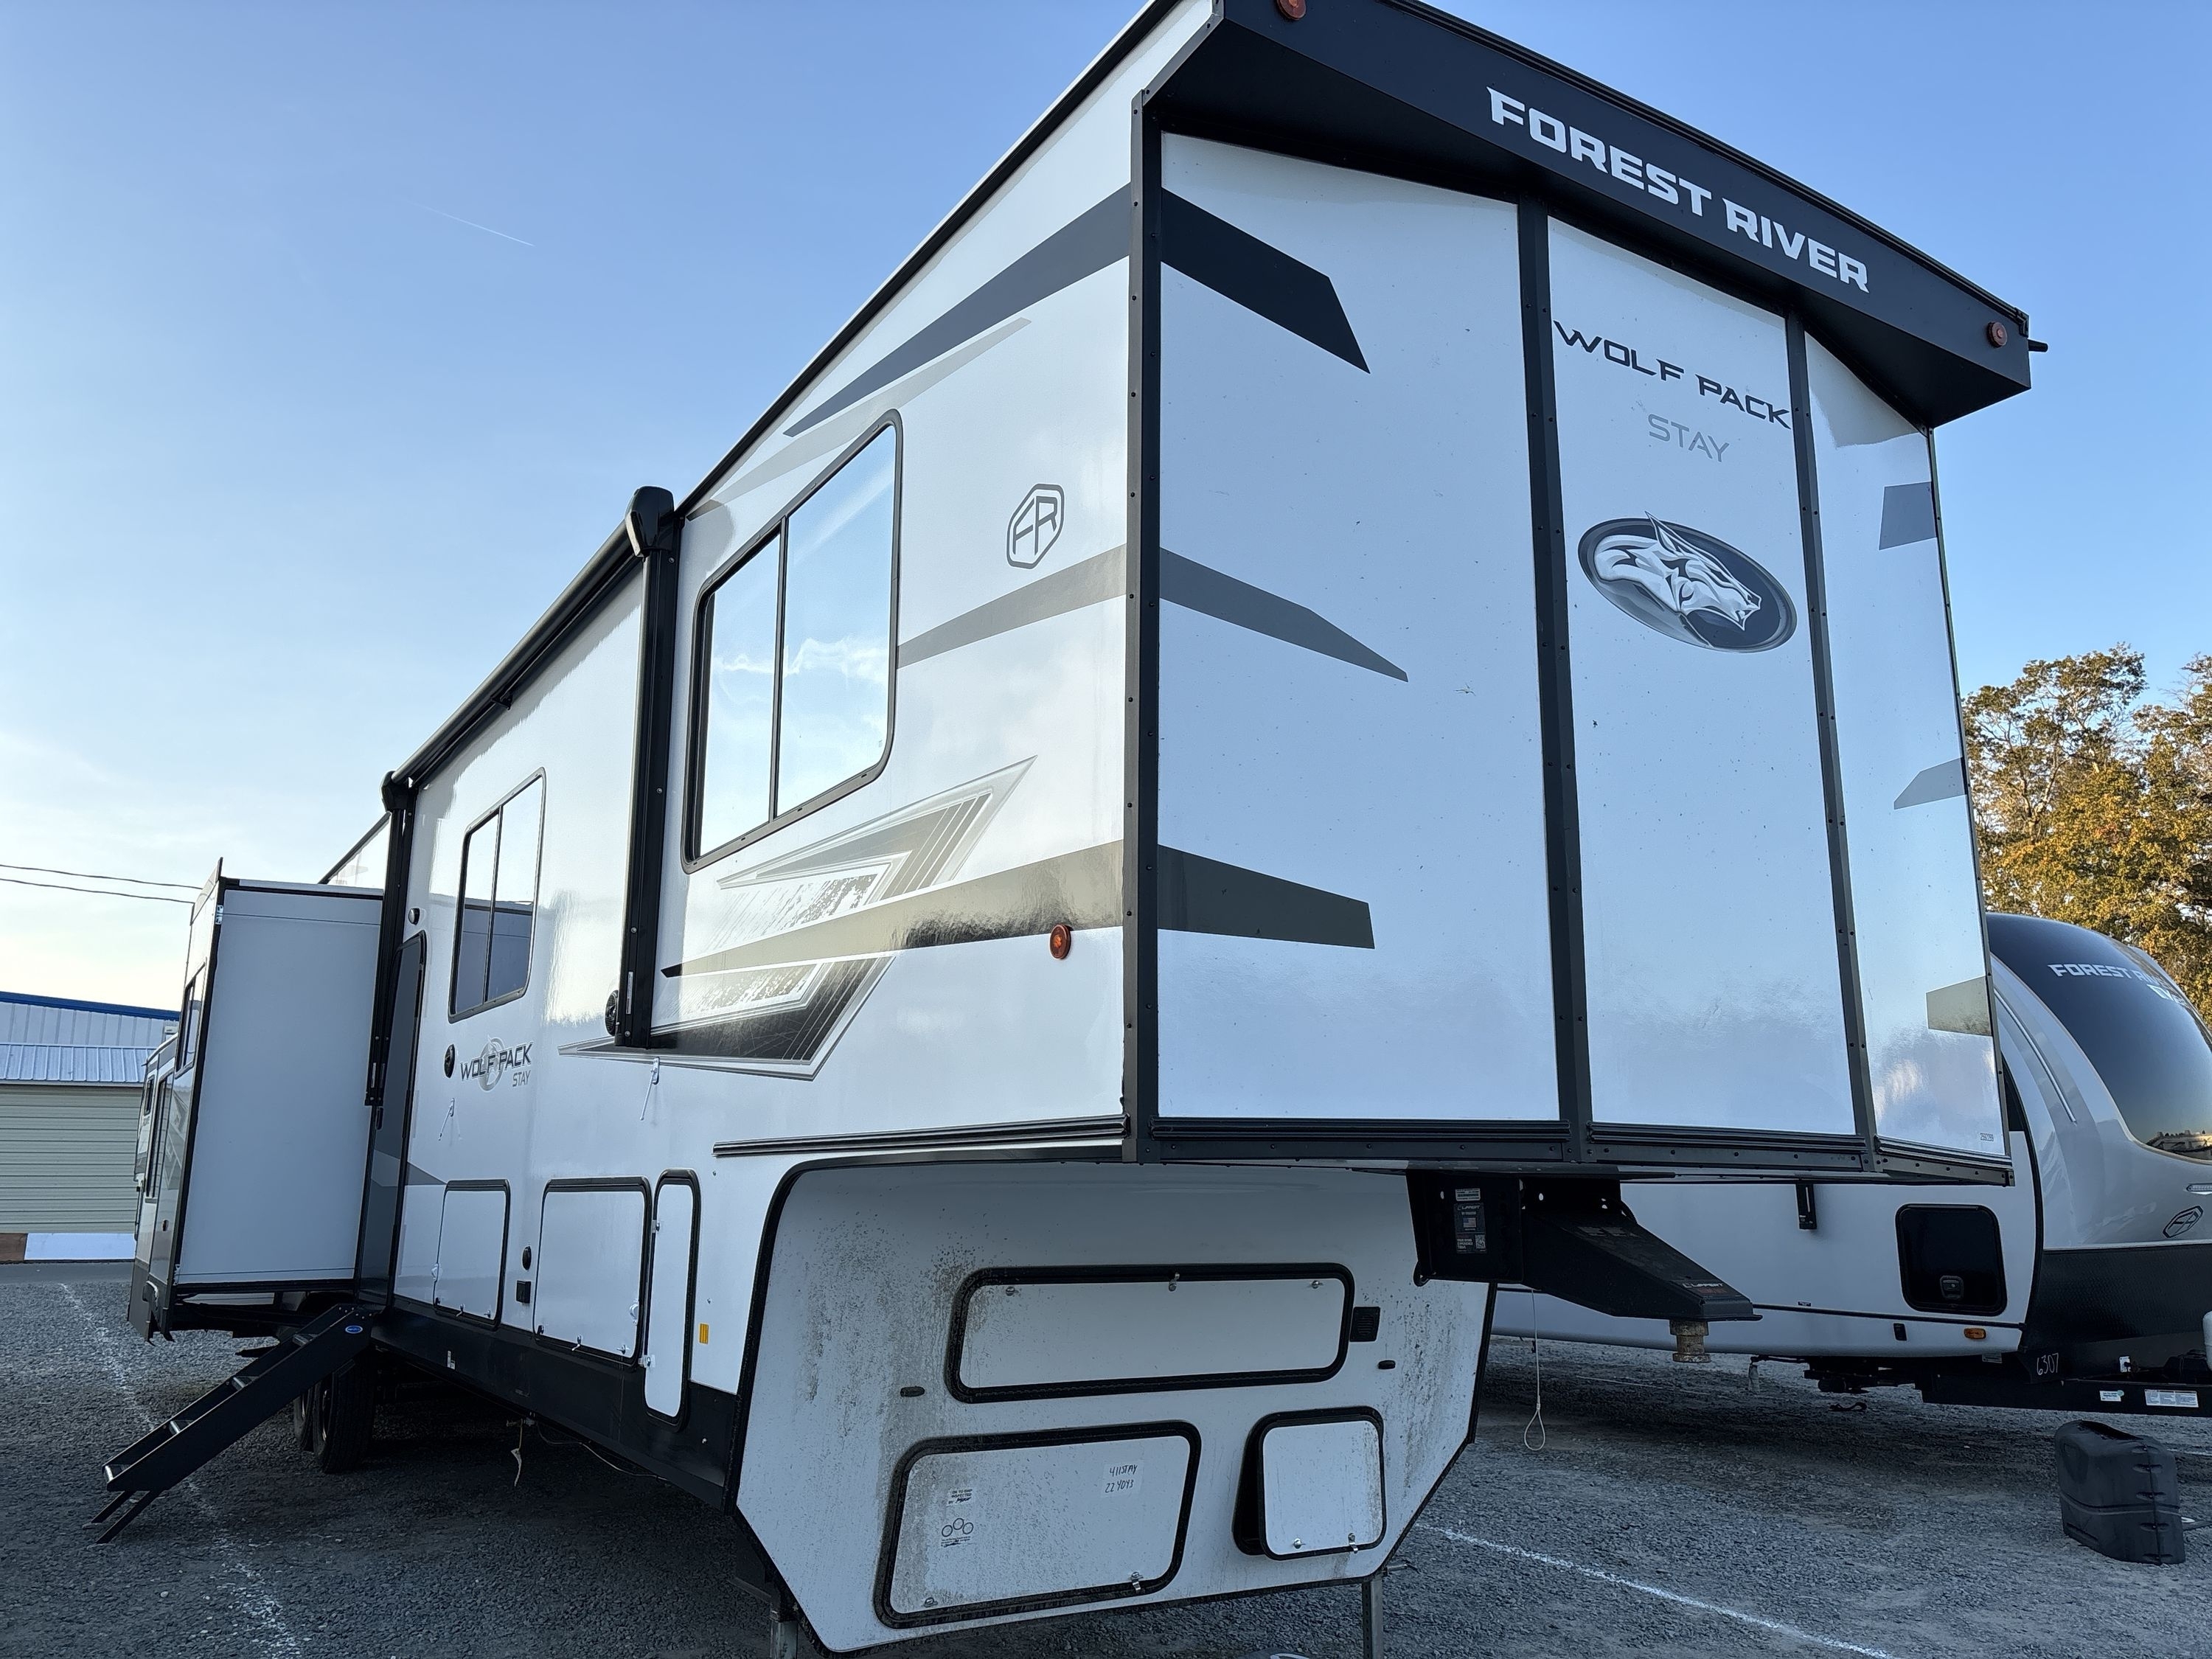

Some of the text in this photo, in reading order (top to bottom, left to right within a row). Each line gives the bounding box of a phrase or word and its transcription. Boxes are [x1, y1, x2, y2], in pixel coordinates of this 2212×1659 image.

[1486, 86, 1869, 293] FOREST RIVER
[1554, 320, 1791, 430] WOLF PACK
[1648, 414, 1730, 462] STAY
[2048, 964, 2132, 979] FOREST
[460, 1043, 533, 1081] WOLF PACK
[512, 1070, 531, 1087] STAY
[2037, 1352, 2059, 1376] 6307
